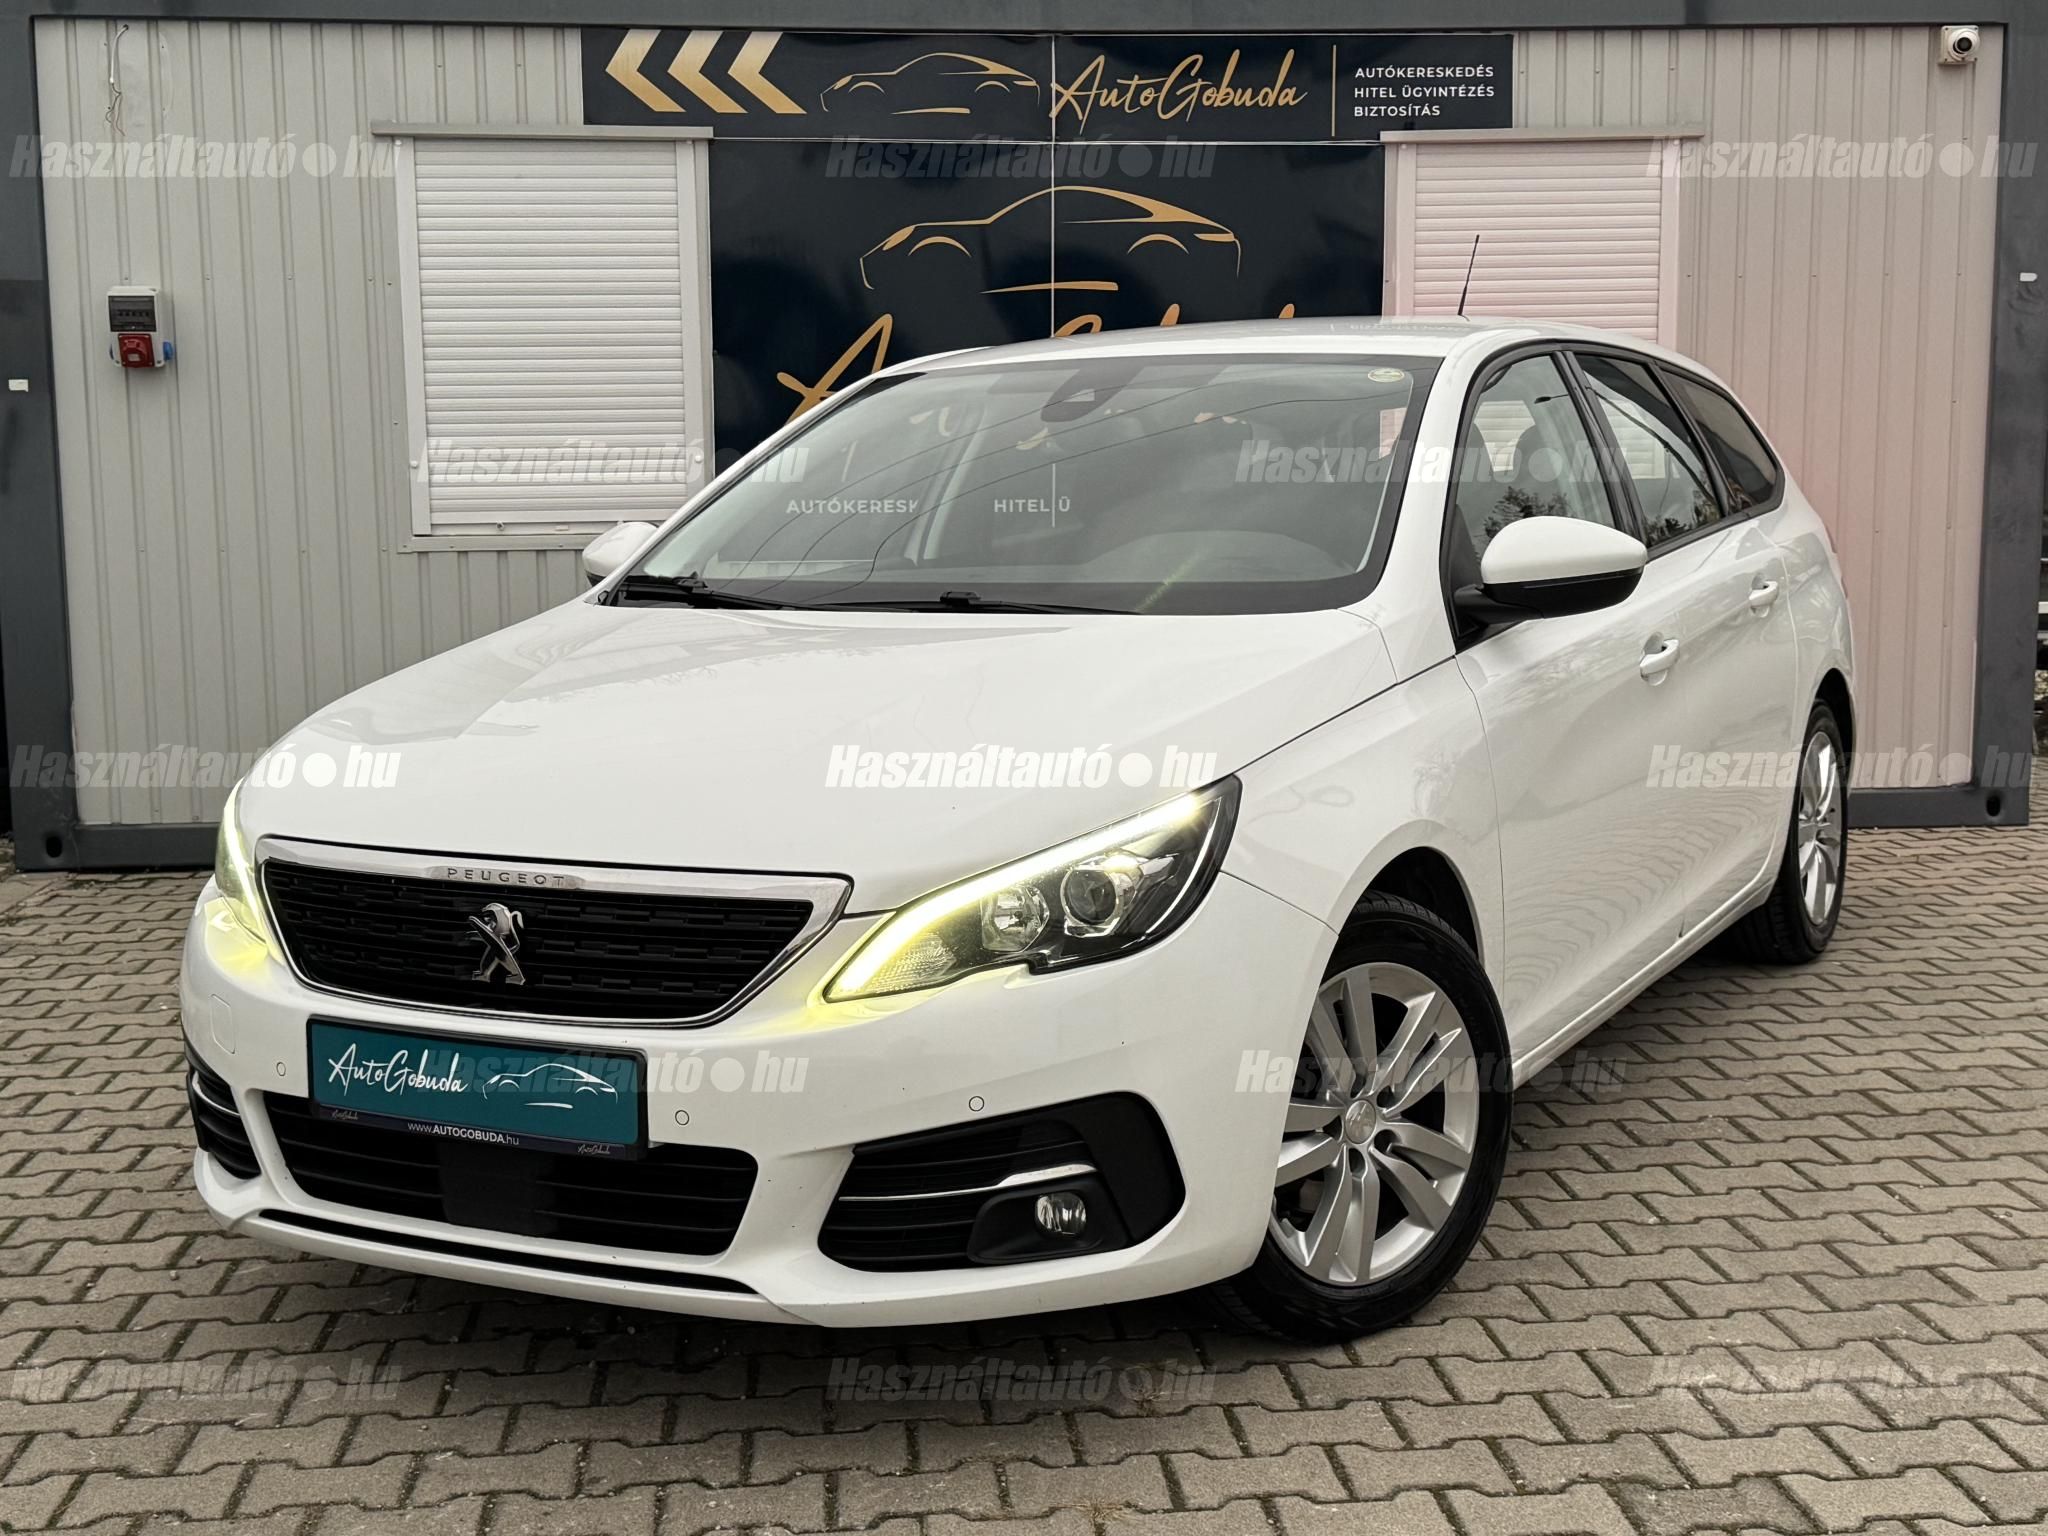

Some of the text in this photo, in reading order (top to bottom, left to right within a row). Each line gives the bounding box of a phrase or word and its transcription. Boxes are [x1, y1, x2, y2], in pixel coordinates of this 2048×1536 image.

[1355, 65, 1495, 79] AUTÓKERESKEDÉS
[1049, 48, 1309, 136] AutoGobuda
[1354, 84, 1495, 99] HITEL ÜGYINTÉZÉS
[1354, 103, 1441, 118] BIZTOSÍTÁS
[994, 499, 1050, 513] HITEL
[447, 867, 564, 888] PEUGEOT
[327, 1043, 469, 1097] AutoGobuda
[408, 1122, 519, 1146] www.AUTOGOBUDA.hu
